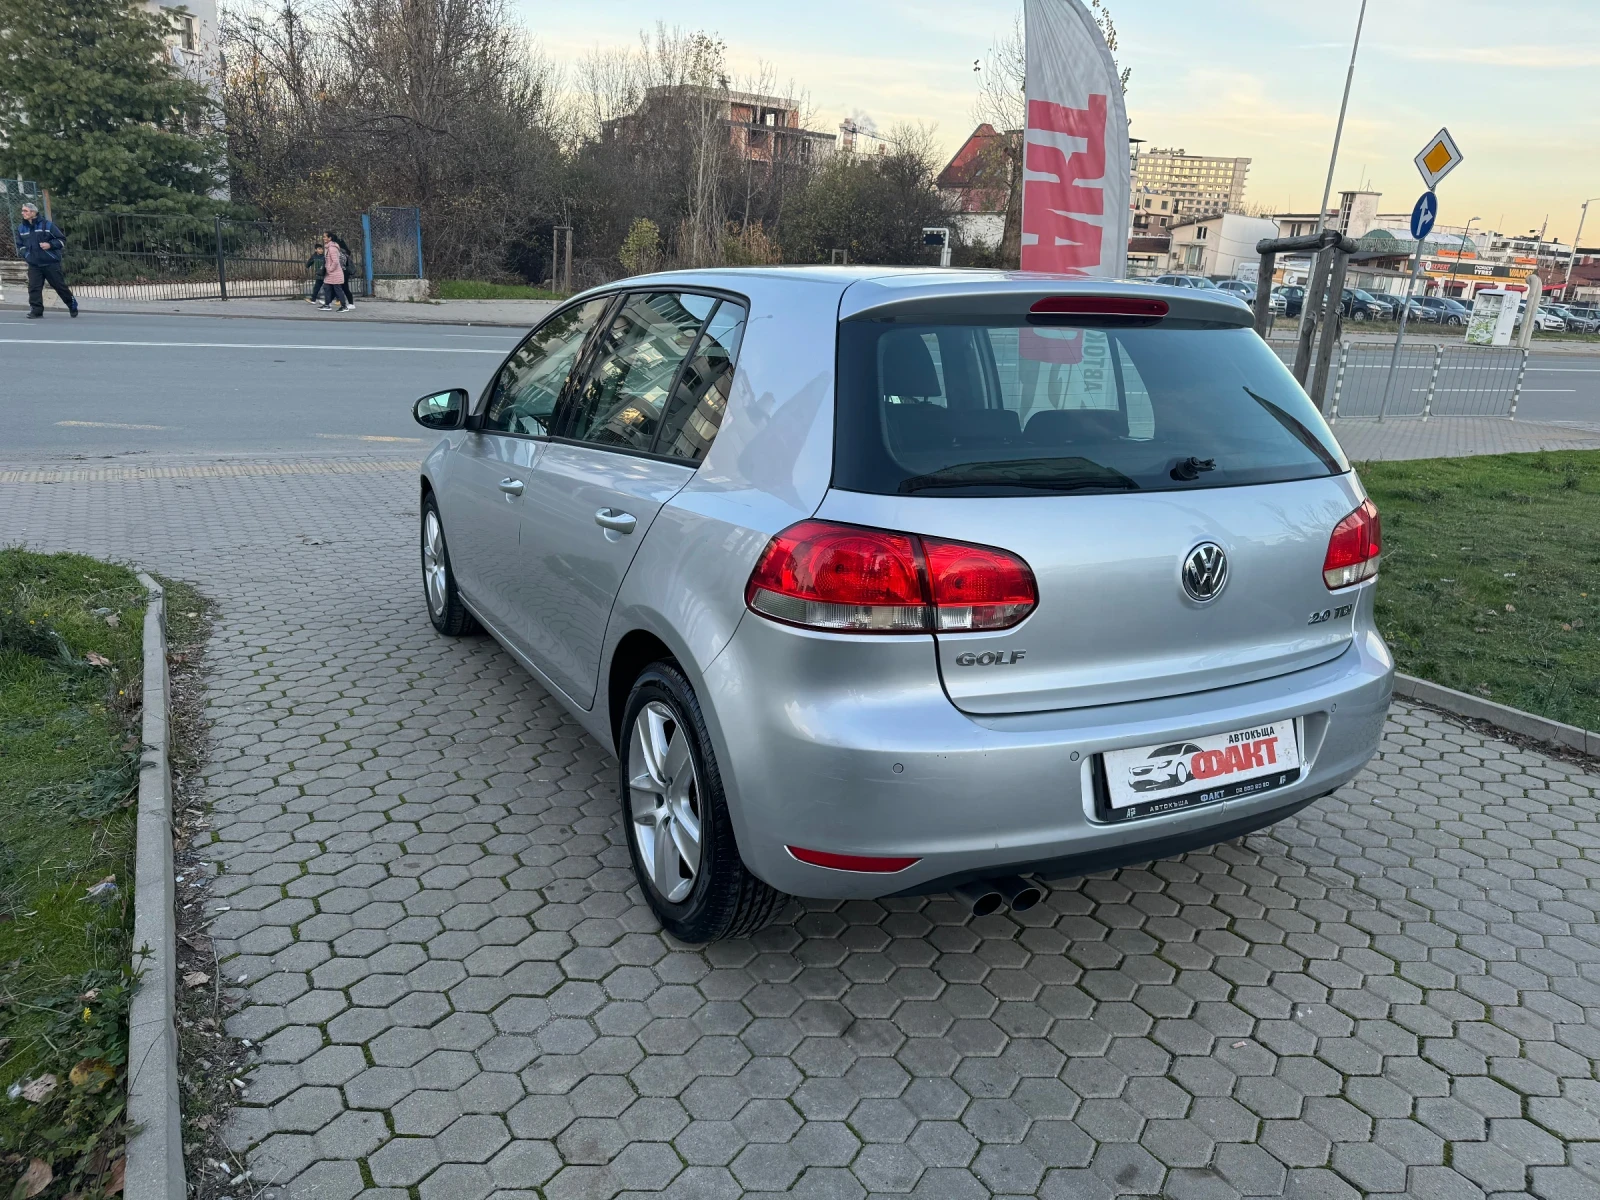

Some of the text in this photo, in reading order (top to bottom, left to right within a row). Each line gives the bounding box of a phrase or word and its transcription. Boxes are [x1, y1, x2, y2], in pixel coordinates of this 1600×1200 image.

[1307, 603, 1353, 625] 2.0 TDI
[955, 649, 1026, 667] GOLF
[1228, 726, 1275, 744] АВТОКЪЩА
[1190, 736, 1278, 780] ФАКТ
[1200, 790, 1225, 802] ФАКТ
